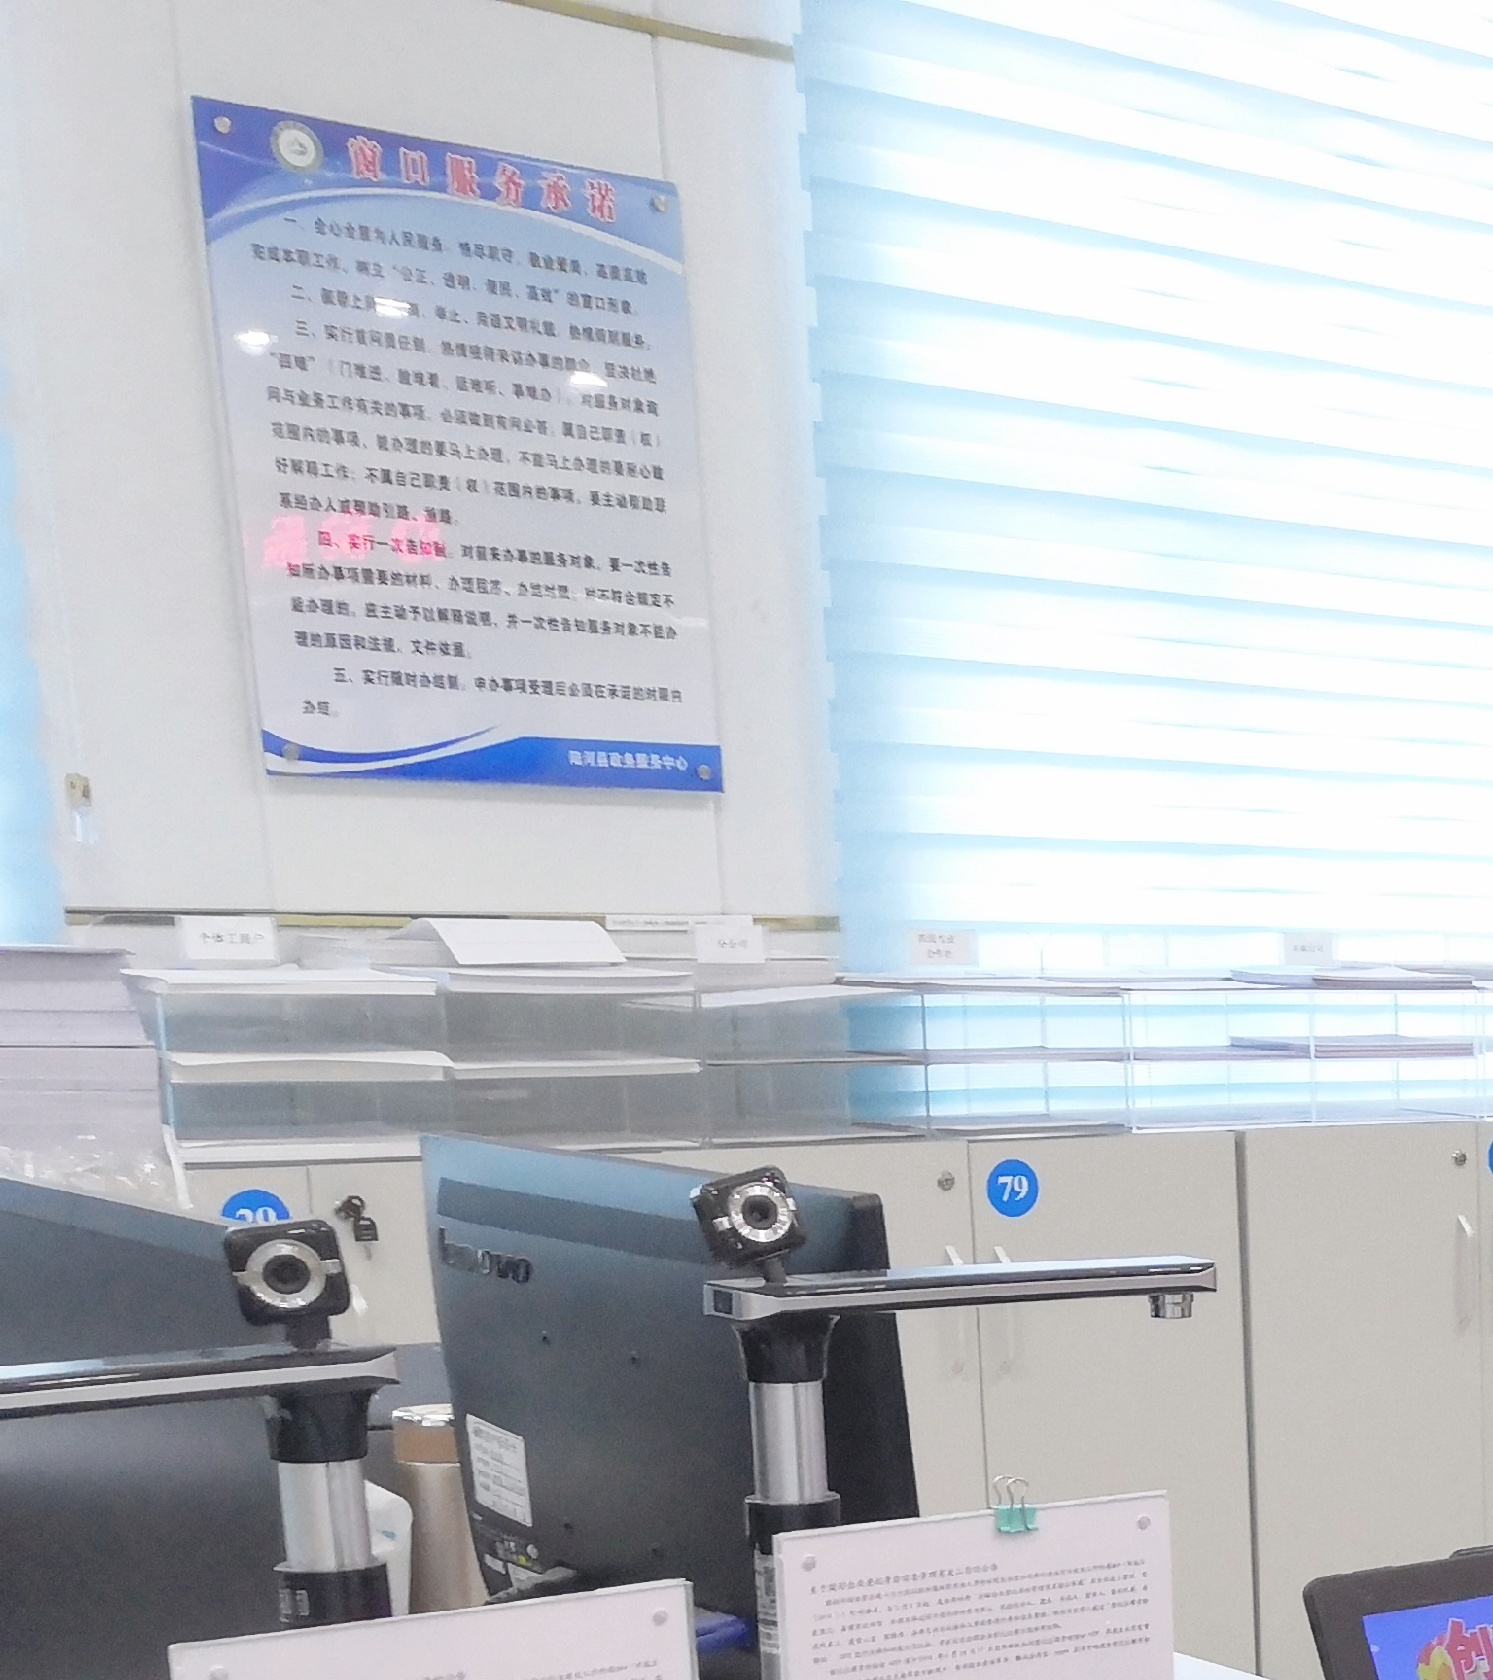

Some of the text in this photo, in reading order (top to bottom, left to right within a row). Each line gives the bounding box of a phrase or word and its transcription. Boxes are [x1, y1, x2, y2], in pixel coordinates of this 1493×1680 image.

[347, 133, 617, 223] 窗口服务承诺
[997, 1175, 1029, 1202] 79
